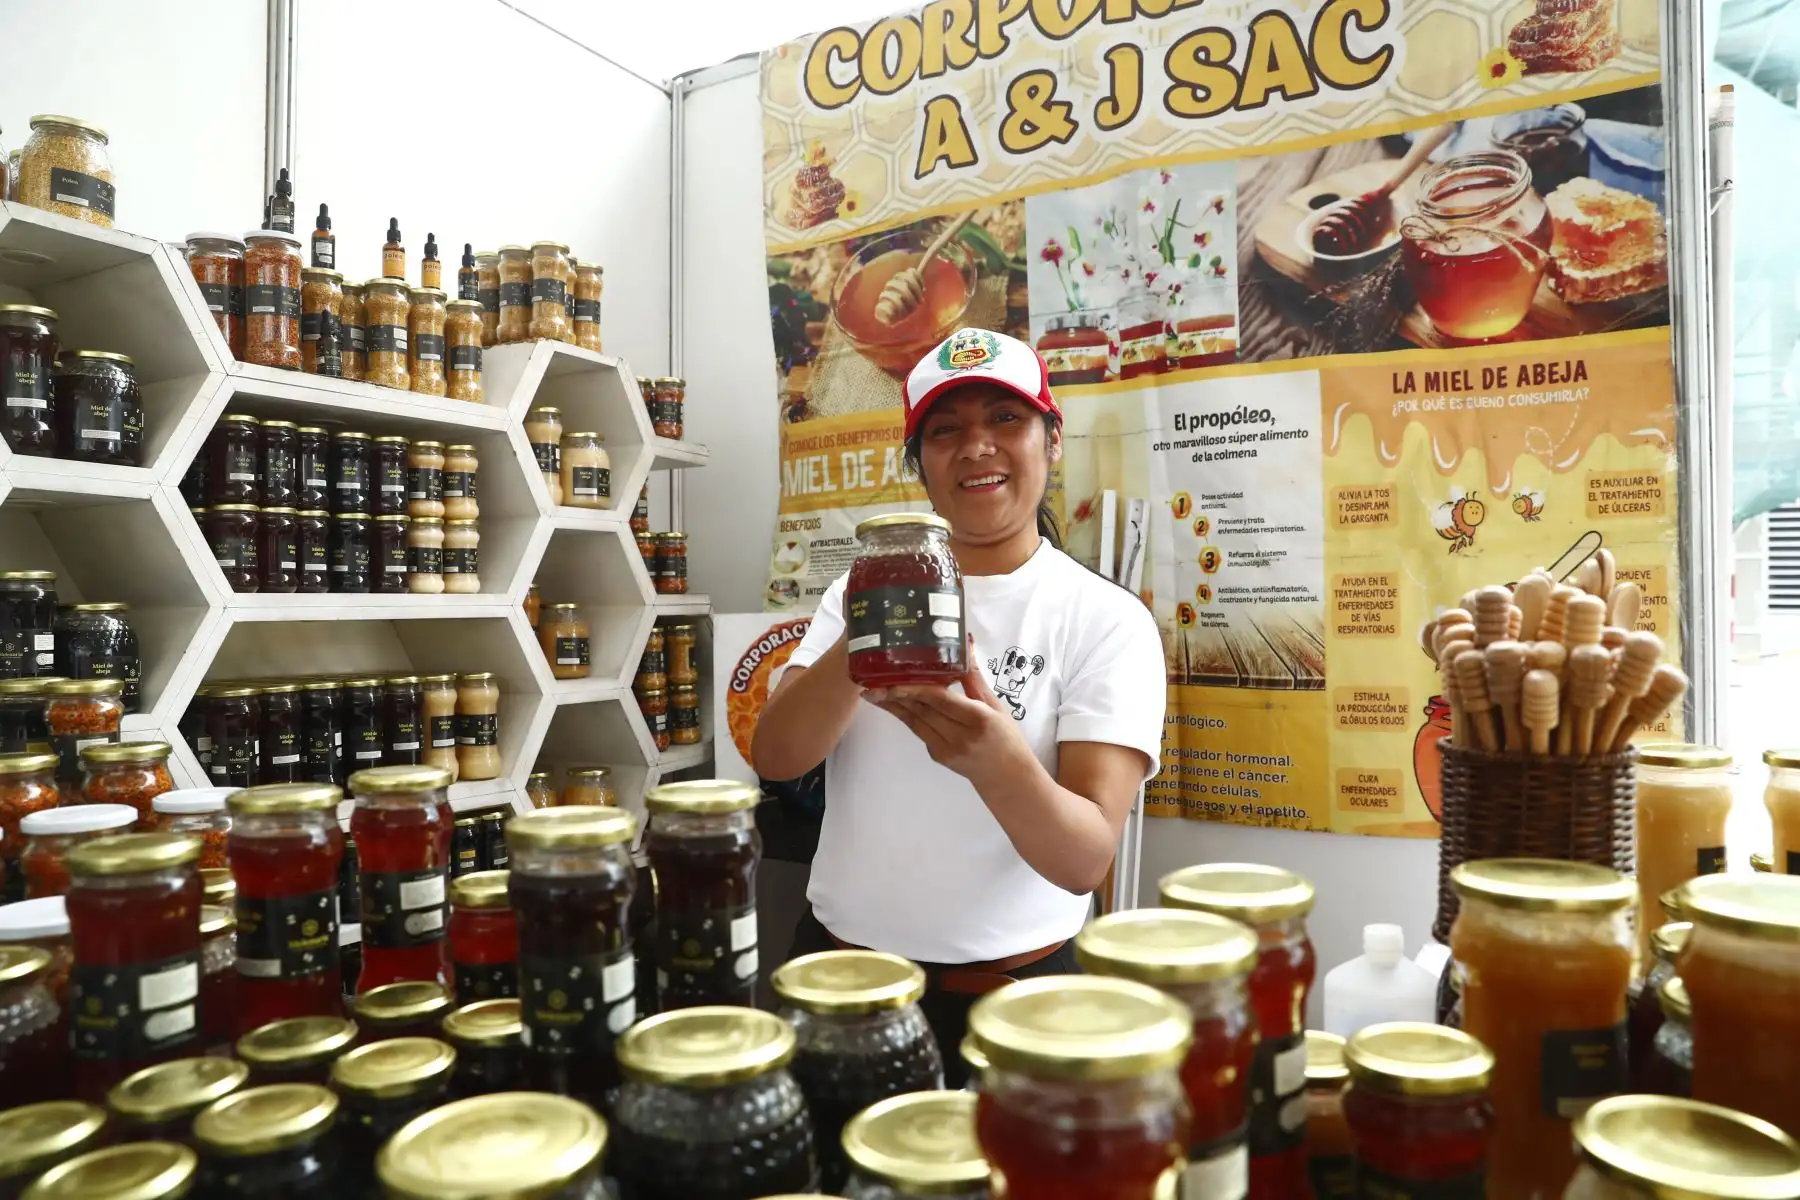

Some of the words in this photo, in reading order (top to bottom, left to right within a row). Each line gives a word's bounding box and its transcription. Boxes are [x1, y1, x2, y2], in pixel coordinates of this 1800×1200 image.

[915, 94, 978, 180] A
[999, 69, 1078, 155] &
[1093, 43, 1143, 131] J
[1163, 0, 1394, 118] SAC
[1392, 371, 1417, 394] LA
[1424, 369, 1473, 393] MIEL
[1482, 366, 1508, 390] DE
[1516, 360, 1588, 388] ABEJA
[1392, 400, 1418, 417] ¿POR
[1422, 395, 1445, 411] QUÉ
[1450, 397, 1463, 410] ES
[1466, 396, 1504, 409] BUENO
[1508, 387, 1590, 407] CONSUMIRLA?
[1174, 413, 1187, 431] El
[1190, 405, 1276, 433] propóleo,
[817, 433, 836, 449] LOS
[837, 428, 891, 447] BENEFICIOS
[1153, 440, 1171, 451] otro
[1173, 434, 1226, 449] maravilloso
[1228, 432, 1258, 446] súper
[1259, 429, 1309, 442] alimento
[1192, 452, 1203, 463] de
[1204, 451, 1213, 462] la
[1214, 449, 1258, 461] colmena
[783, 454, 837, 498] MIEL
[842, 448, 876, 491] DE
[1590, 479, 1601, 489] ES
[1603, 476, 1643, 488] AUXILIAR
[1646, 476, 1658, 486] EN
[1338, 491, 1362, 500] ALIVIA
[1364, 490, 1373, 499] LA
[1374, 489, 1390, 498] TOS
[1588, 491, 1598, 502] EL
[1600, 488, 1661, 501] TRATAMIENTO
[1178, 497, 1185, 514] 1
[1345, 502, 1389, 512] DESINFLAMA
[1599, 504, 1608, 514] DE
[1612, 502, 1651, 513] ÚLCERAS
[780, 517, 821, 532] BENEFICIOS
[1339, 514, 1349, 524] LA
[1350, 513, 1389, 523] GARGANTA
[1198, 520, 1205, 533] 2
[1218, 526, 1260, 535] enfermedades
[1205, 551, 1216, 569] 3
[1342, 577, 1366, 587] AYUDA
[1368, 576, 1378, 586] EN
[1380, 576, 1389, 586] EL
[805, 586, 829, 596] ANTISÉ
[1200, 588, 1207, 600] 4
[1335, 588, 1386, 599] TRATAMIENTO
[1387, 588, 1397, 598] DE
[1338, 601, 1394, 611] ENFERMEDADES
[1181, 608, 1191, 624] 5
[1351, 613, 1361, 623] DE
[1364, 611, 1381, 622] VÍAS
[1338, 624, 1395, 635] RESPIRATORIAS
[1354, 692, 1390, 702] ESTIMULA
[1336, 704, 1346, 713] LA
[1347, 702, 1397, 713] PRODUCCIÓN
[1399, 704, 1408, 713] DE
[1340, 714, 1378, 725] GLÓBULOS
[1380, 717, 1405, 725] ROJOS
[1225, 751, 1294, 767] hormonal.
[1223, 768, 1234, 778] el
[1238, 769, 1289, 783] cáncer.
[1358, 774, 1379, 783] CURA
[1211, 783, 1262, 799] células.
[1341, 786, 1397, 796] ENFERMEDADES
[1350, 797, 1389, 808] OCULARES
[1230, 803, 1238, 815] y
[1241, 801, 1252, 813] el
[1257, 805, 1311, 819] apetito.
